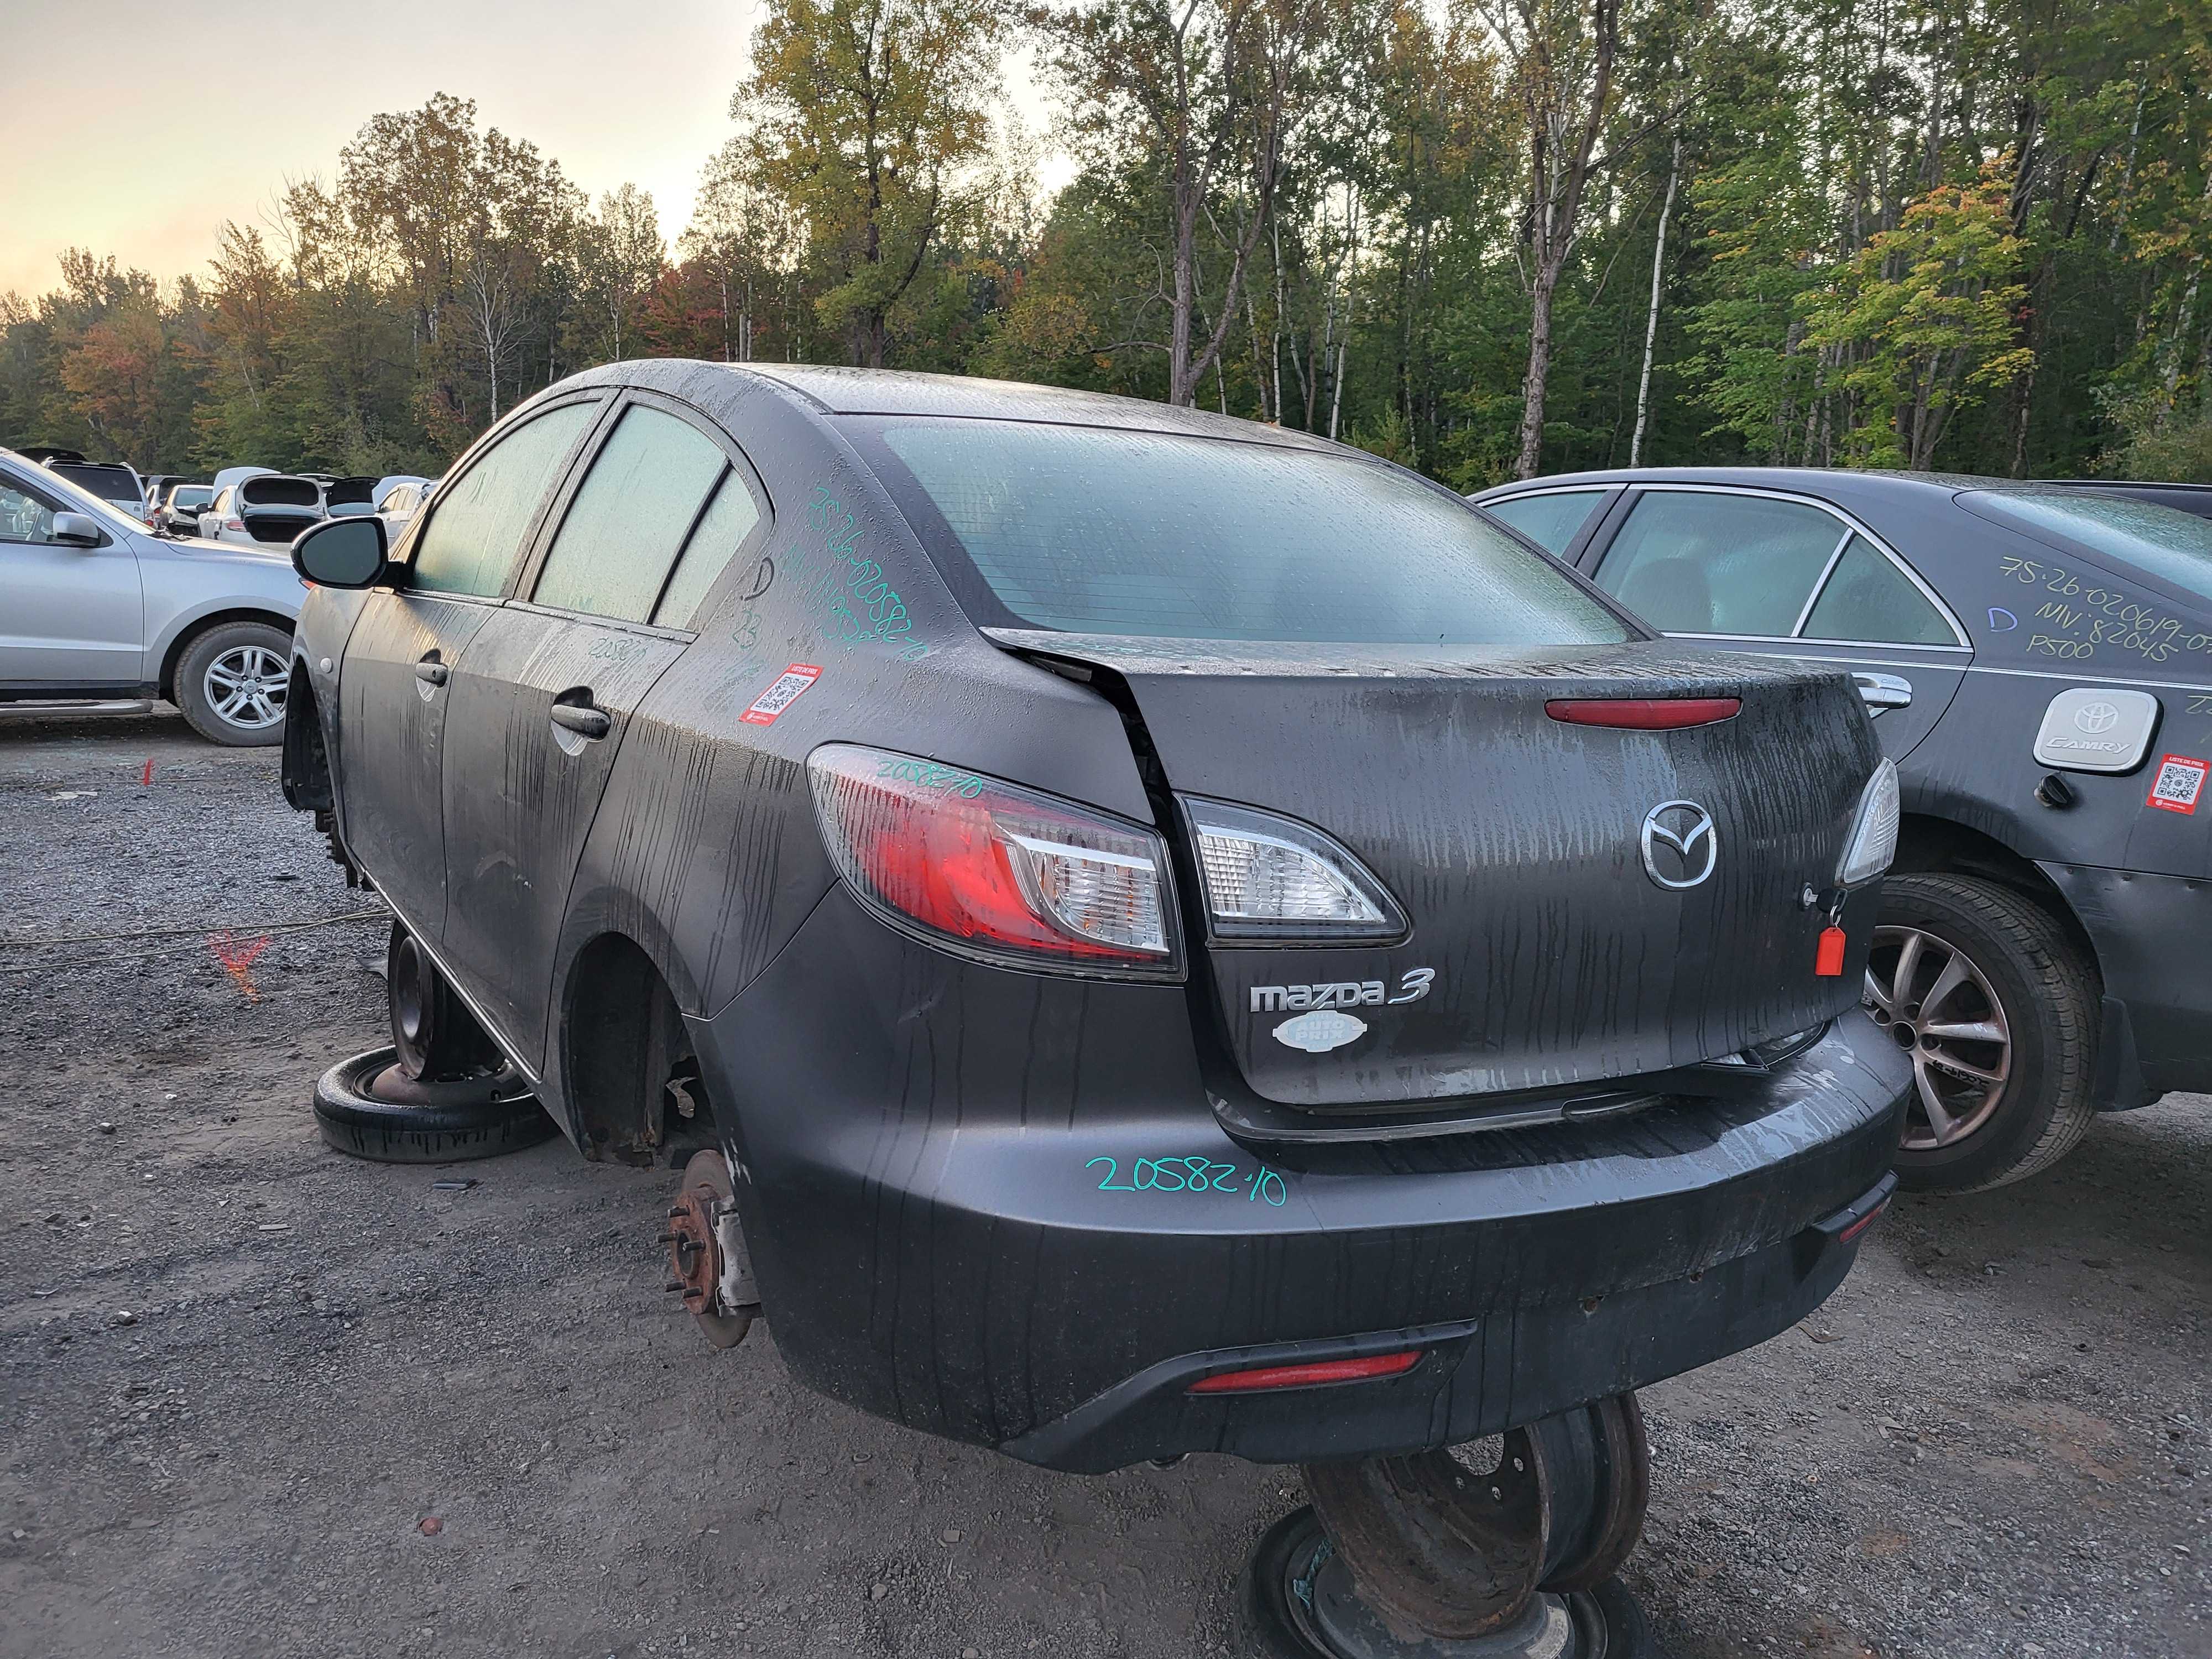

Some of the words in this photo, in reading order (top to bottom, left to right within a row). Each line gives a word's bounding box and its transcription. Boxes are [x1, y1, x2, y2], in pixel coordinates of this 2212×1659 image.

[1988, 607, 2018, 632] D
[2026, 634, 2094, 659] P500
[2089, 618, 2179, 662] 82045
[2046, 736, 2132, 754] CAMRY
[1387, 967, 1436, 1004] 3
